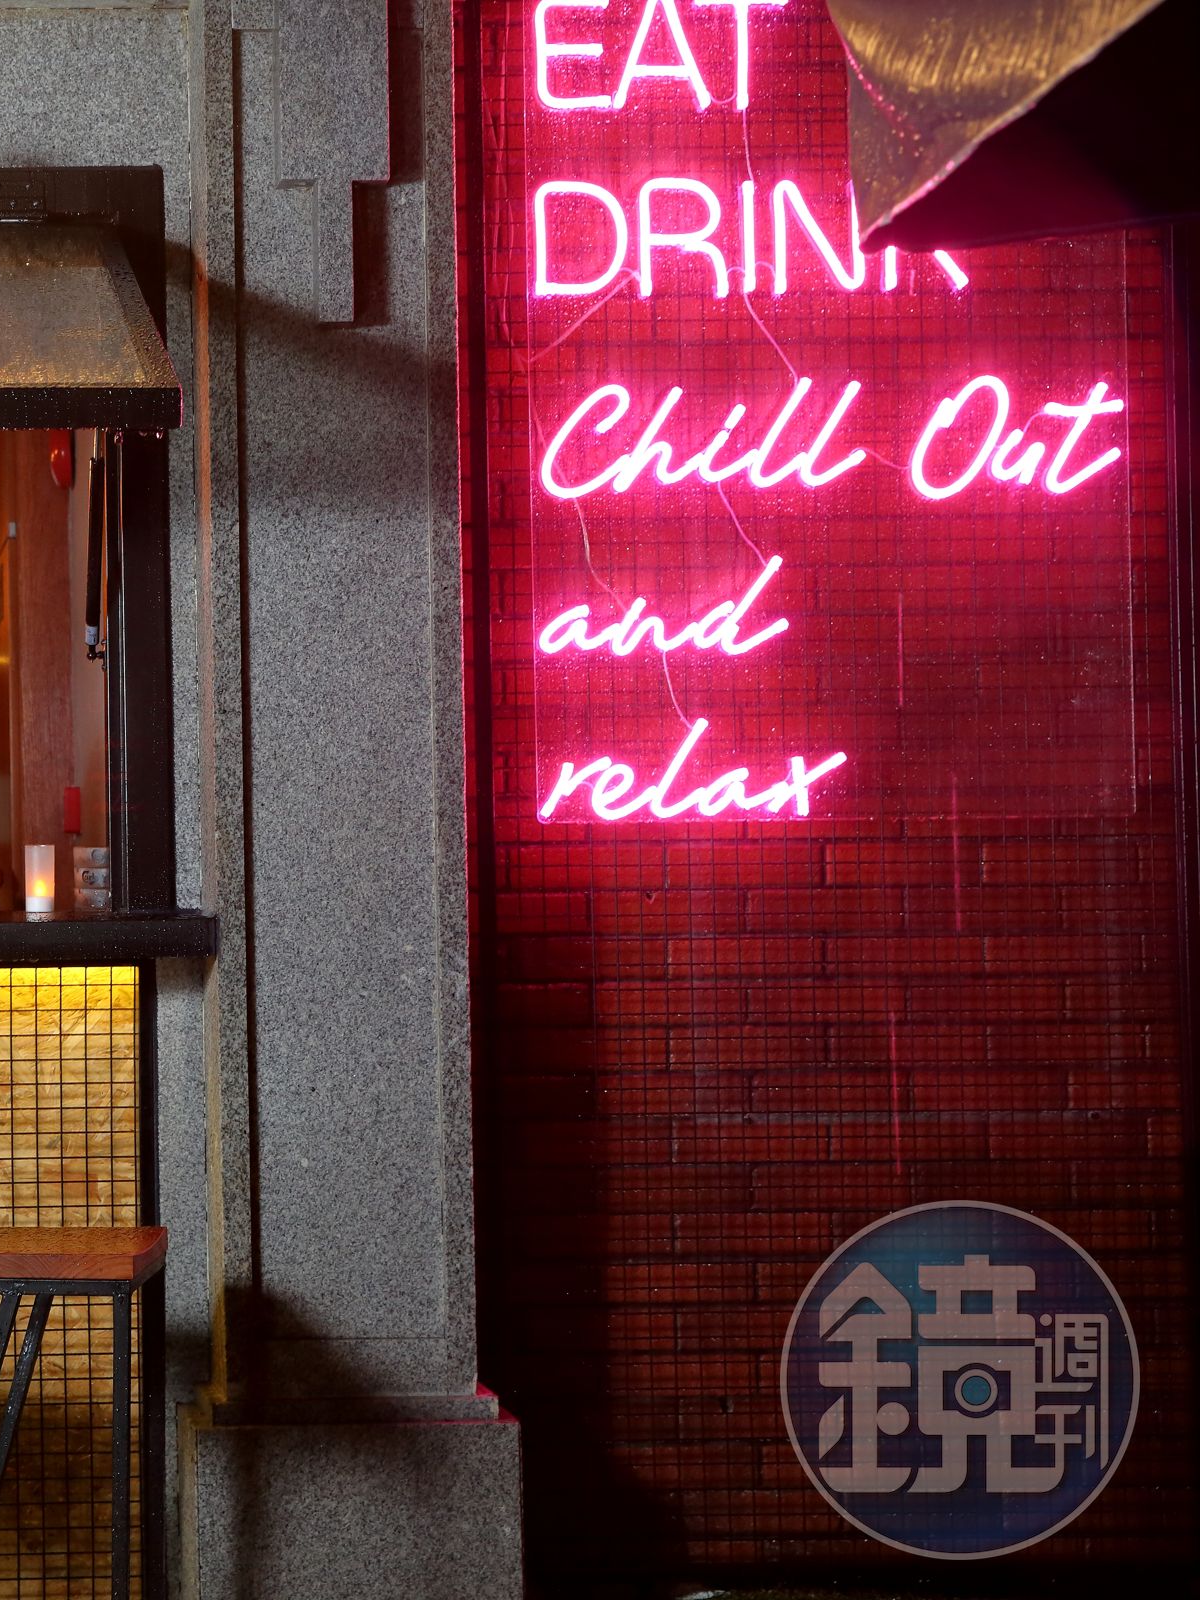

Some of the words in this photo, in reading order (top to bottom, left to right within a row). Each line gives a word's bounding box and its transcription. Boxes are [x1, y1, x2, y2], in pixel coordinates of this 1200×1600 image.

[535, 0, 788, 111] EAT
[541, 377, 866, 499] Chill
[911, 375, 1124, 500] Out
[539, 555, 789, 656] and
[540, 718, 847, 820] relax
